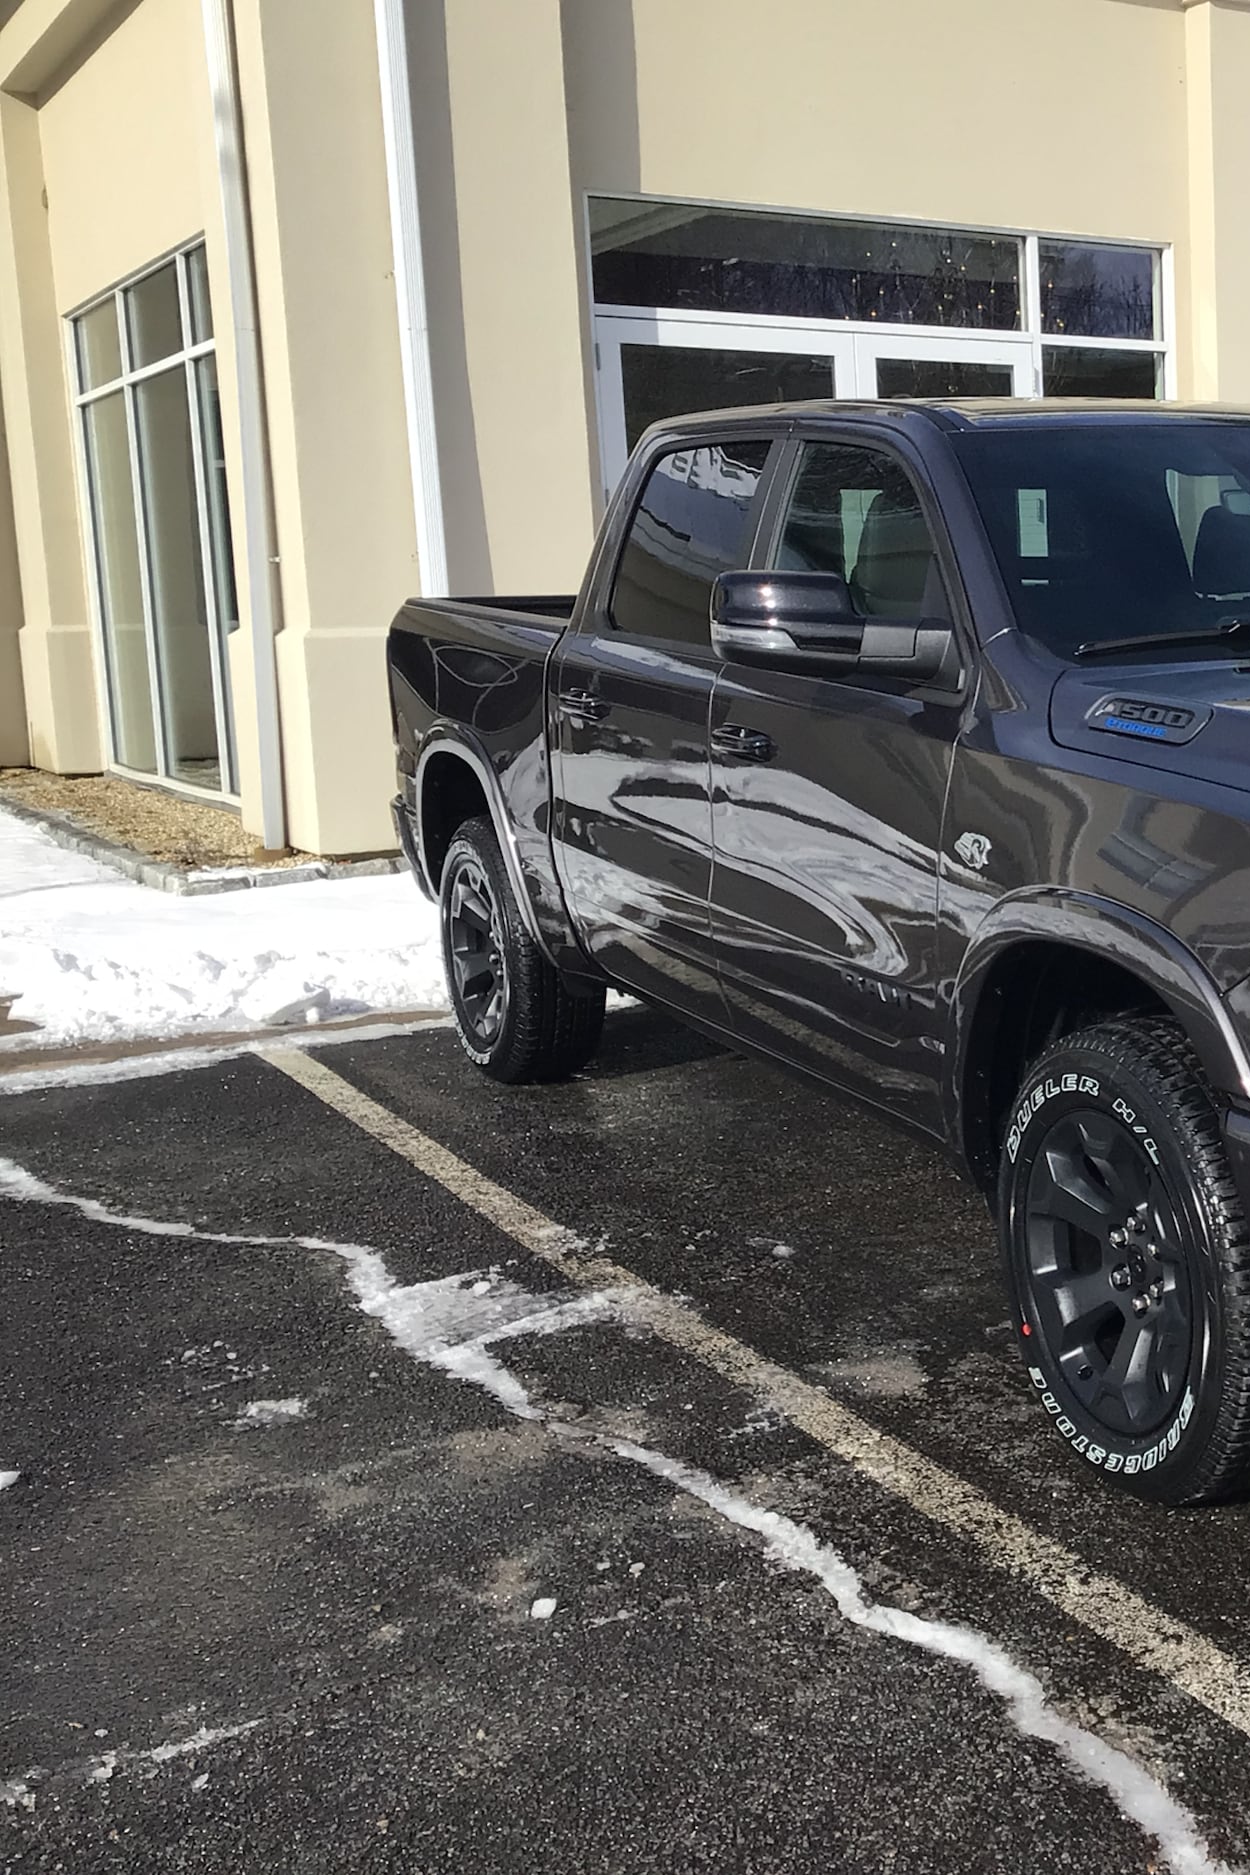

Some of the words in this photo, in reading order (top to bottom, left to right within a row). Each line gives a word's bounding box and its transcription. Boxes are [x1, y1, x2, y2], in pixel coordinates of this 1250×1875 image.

[1103, 701, 1195, 727] 1500
[1007, 1073, 1100, 1163] DUELER
[1028, 1367, 1195, 1474] BRIDGESTONE
